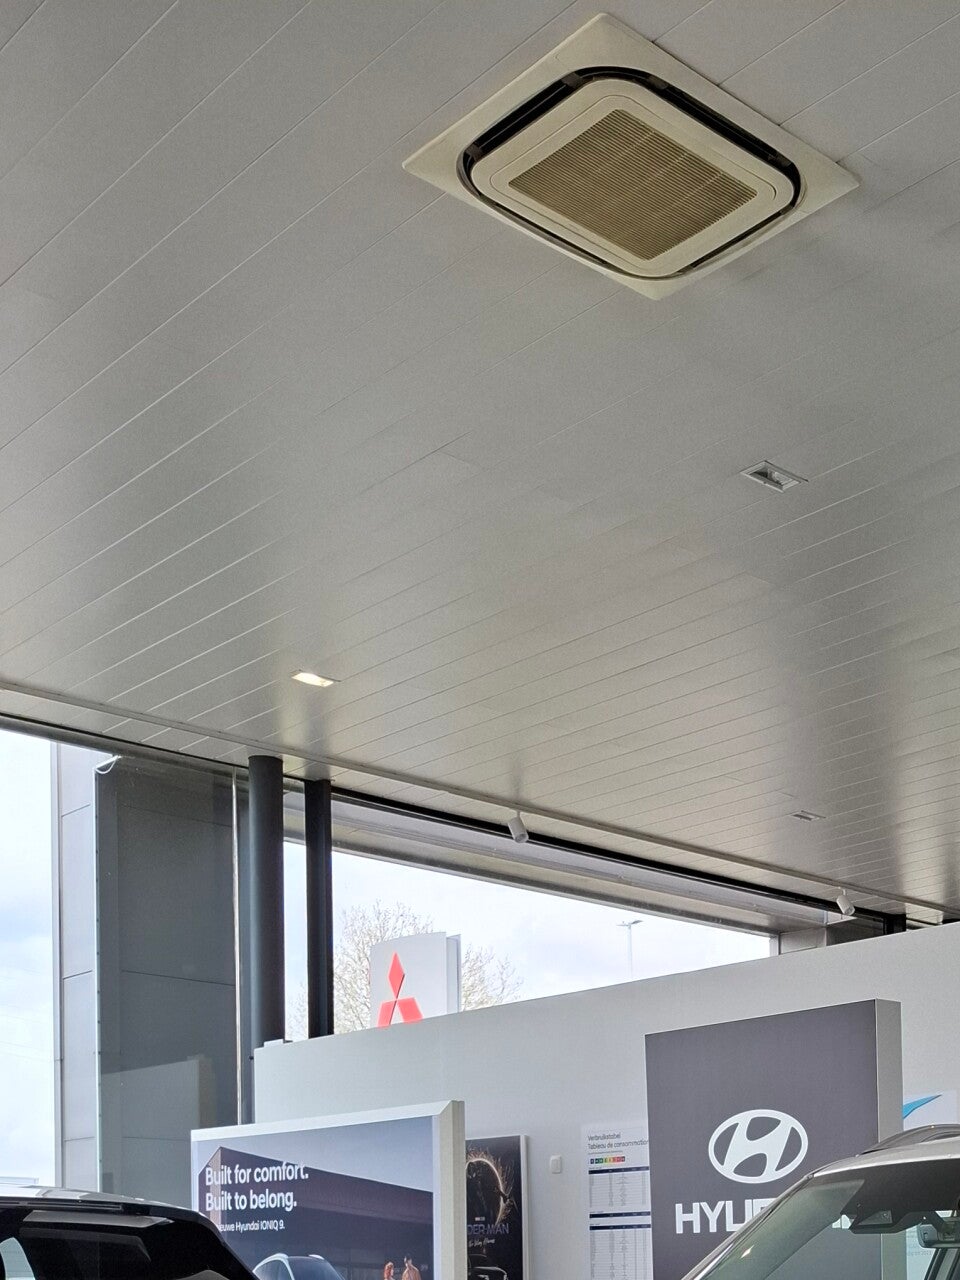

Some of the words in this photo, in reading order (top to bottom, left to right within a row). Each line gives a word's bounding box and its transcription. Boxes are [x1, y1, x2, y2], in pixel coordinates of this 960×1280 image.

[205, 1165, 232, 1186] Built
[234, 1164, 252, 1184] for
[253, 1161, 309, 1183] comfort.
[205, 1190, 232, 1212] Built
[234, 1191, 248, 1210] to
[249, 1188, 298, 1212] belong.
[235, 1220, 260, 1234] Hyundai
[260, 1220, 279, 1231] IONIQ
